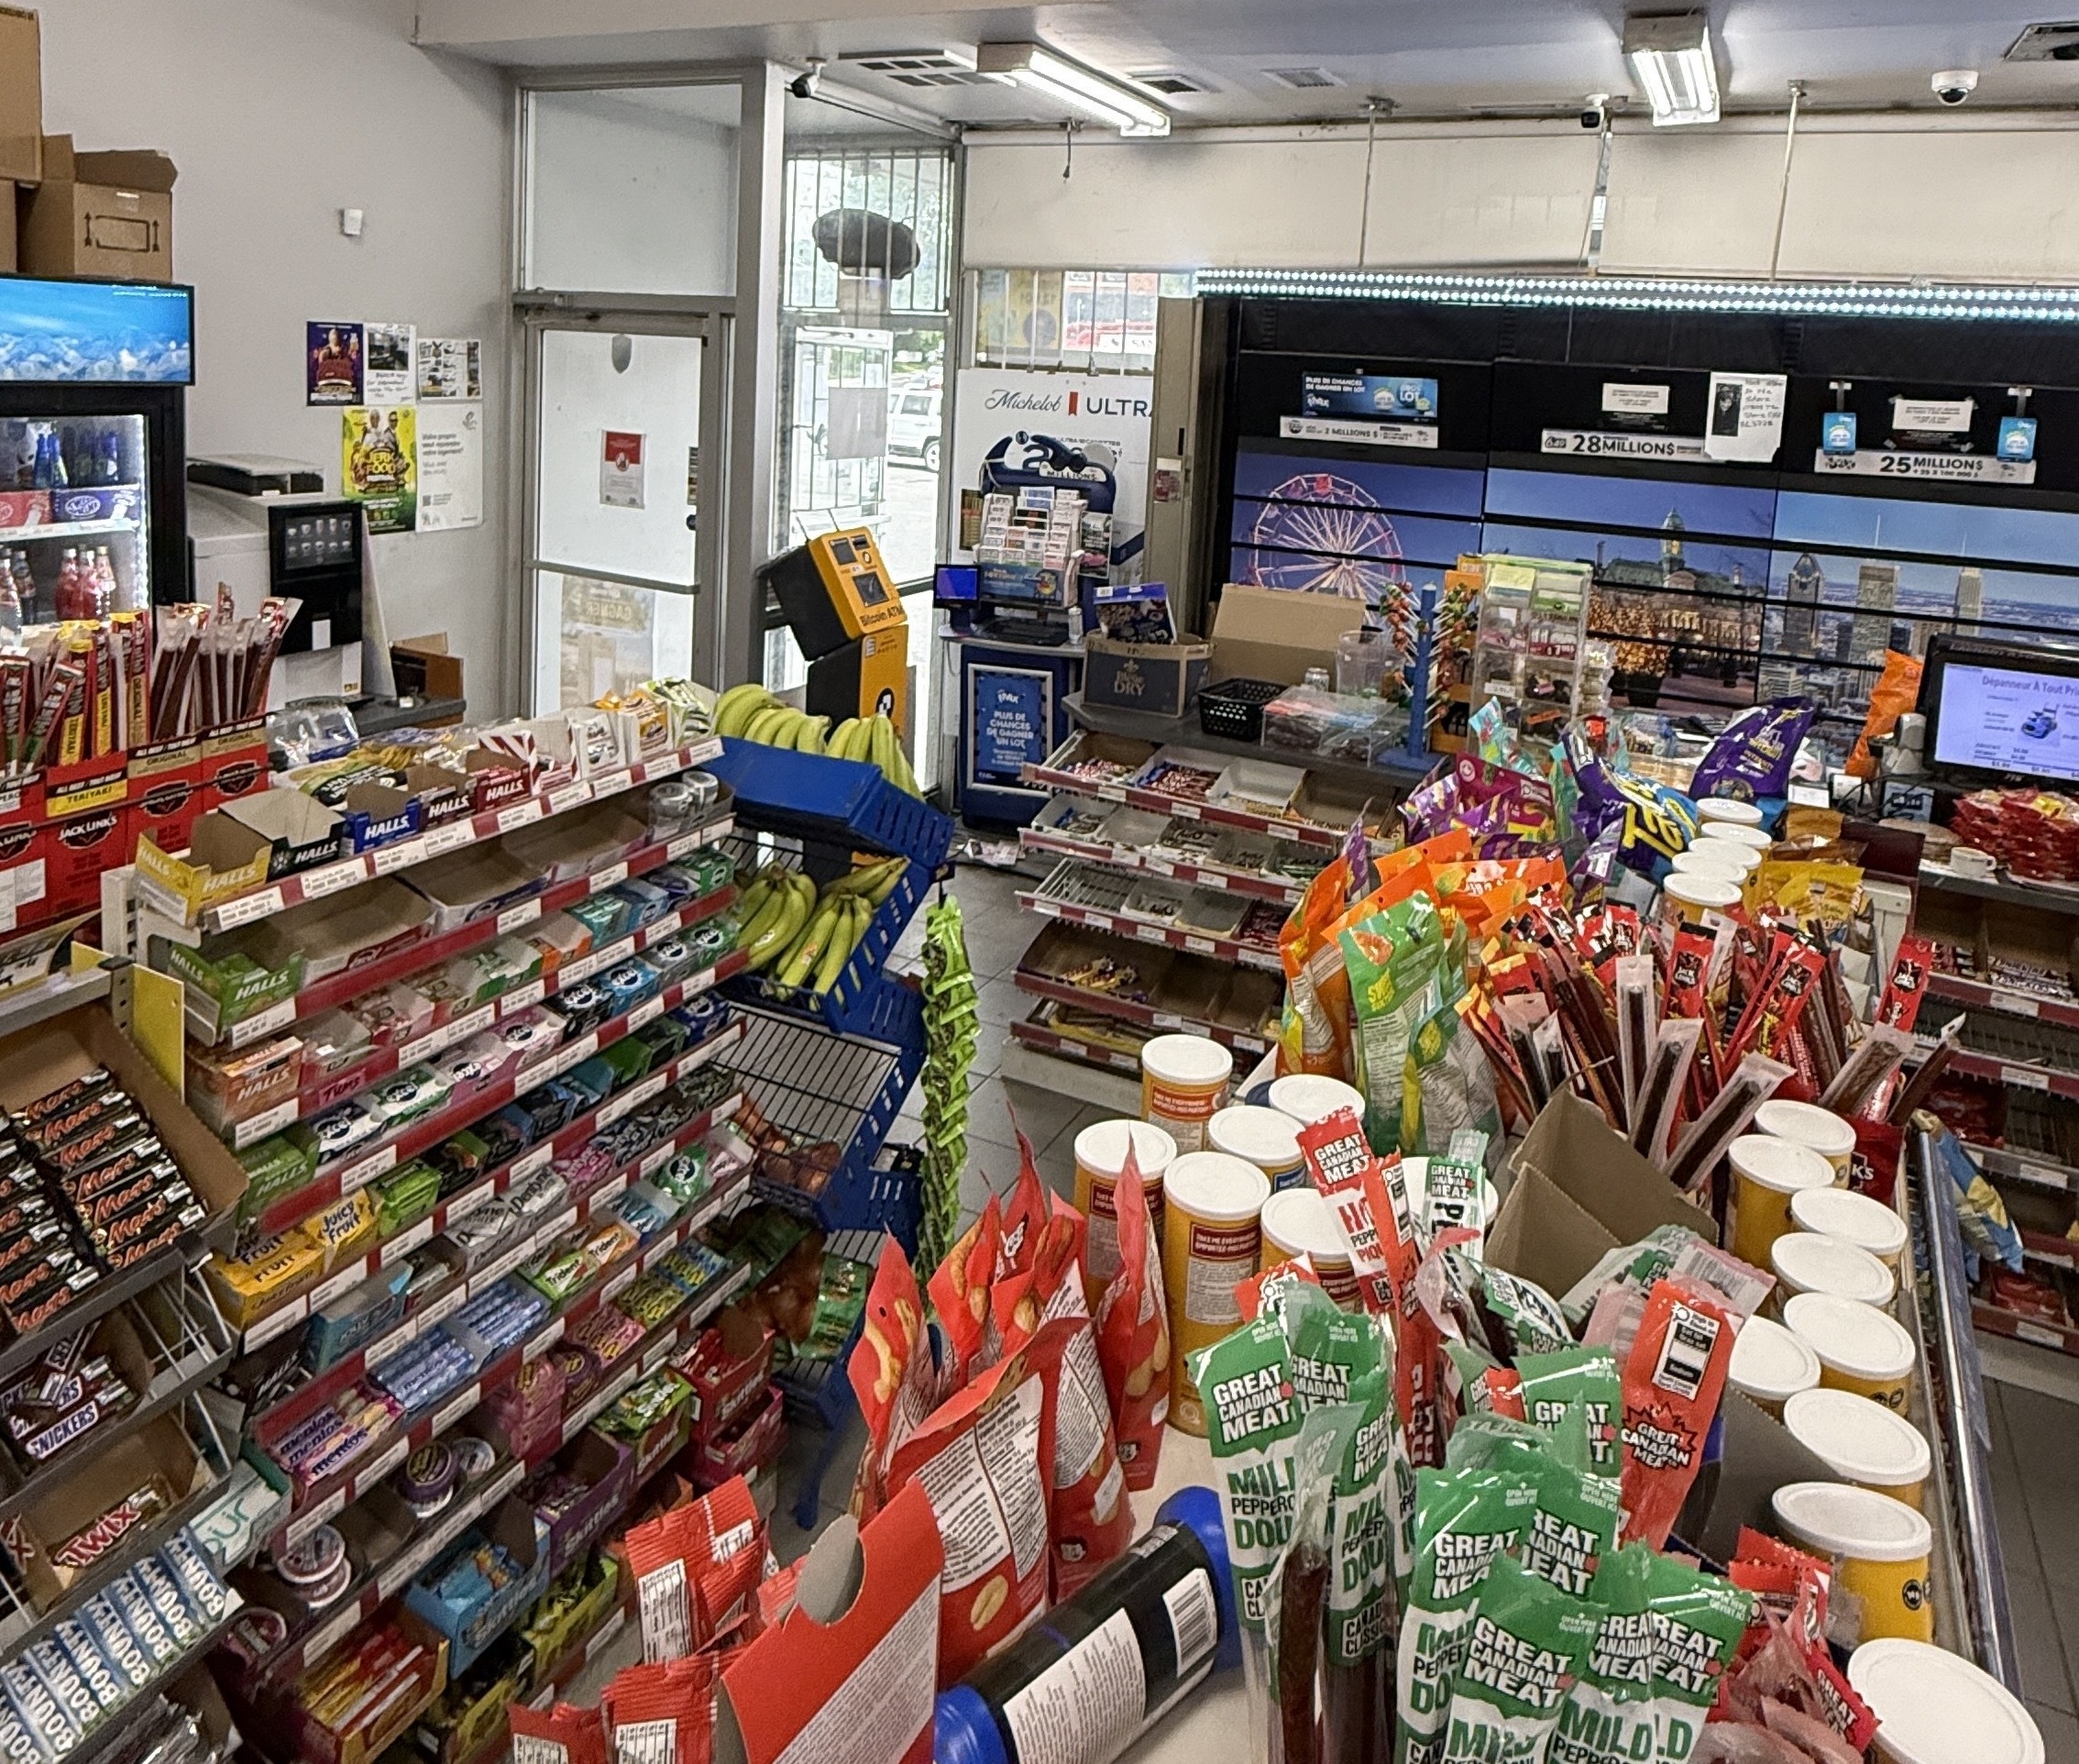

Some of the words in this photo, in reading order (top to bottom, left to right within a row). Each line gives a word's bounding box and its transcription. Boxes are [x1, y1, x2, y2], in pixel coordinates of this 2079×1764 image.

[984, 389, 1062, 413] Michelob
[1400, 391, 1420, 402] LOT
[1572, 435, 1601, 454] 28
[1879, 456, 1911, 474] 25
[859, 611, 887, 627] Bitcoin
[1982, 676, 2031, 690] Dépanneur
[2064, 685, 2079, 696] Pri
[990, 719, 1030, 730] CHANCES
[994, 711, 1014, 721] PLUS
[998, 729, 1034, 740] GAGNER
[147, 750, 187, 766] ORIGINAL
[66, 786, 114, 804] TERIYAKI
[486, 779, 524, 801] HALLS
[428, 794, 469, 819] HALLS
[58, 822, 86, 841] JACK
[365, 815, 410, 840] HALLS
[294, 841, 339, 865] HALLS
[202, 865, 257, 893] HALLS
[170, 949, 204, 983] HALLS
[234, 970, 290, 1002] HALLS
[237, 1067, 290, 1101] HALLS
[1314, 1133, 1363, 1162] GREAT
[1320, 1146, 1363, 1173] CANADIAN
[77, 1152, 137, 1203] Mars
[1324, 1154, 1374, 1184] MEAT
[1430, 1164, 1471, 1180] GREAT
[94, 1174, 155, 1226] Mars
[510, 1169, 551, 1215] Dentyne
[1430, 1184, 1470, 1198] MEAT
[108, 1197, 167, 1245] Mars
[322, 1201, 355, 1233] Juicy
[588, 1230, 620, 1257] Trident
[544, 1258, 579, 1287] Trident
[1212, 1362, 1282, 1406] GREAT
[1218, 1384, 1283, 1422] CANADIAN
[1534, 1401, 1611, 1423] GRAT
[30, 1404, 96, 1456] SNICKERS
[1222, 1399, 1291, 1444] MEAT
[312, 1427, 368, 1476] mentos
[1621, 1428, 1689, 1466] CANADIAN
[1633, 1446, 1668, 1468] MEAT
[55, 1503, 141, 1566] TWIX
[1234, 1516, 1292, 1549] DOU
[1434, 1527, 1520, 1558] GREAT
[1342, 1537, 1387, 1593] DOU
[1432, 1565, 1491, 1599] MEA
[1346, 1603, 1382, 1638] CANAD
[1474, 1615, 1574, 1674] GREAT
[1651, 1613, 1723, 1659] REAT
[1470, 1640, 1559, 1688] CANADIAN
[1651, 1652, 1711, 1693] EAT
[1464, 1659, 1561, 1708] MEAT
[1558, 1699, 1649, 1761] MILD
